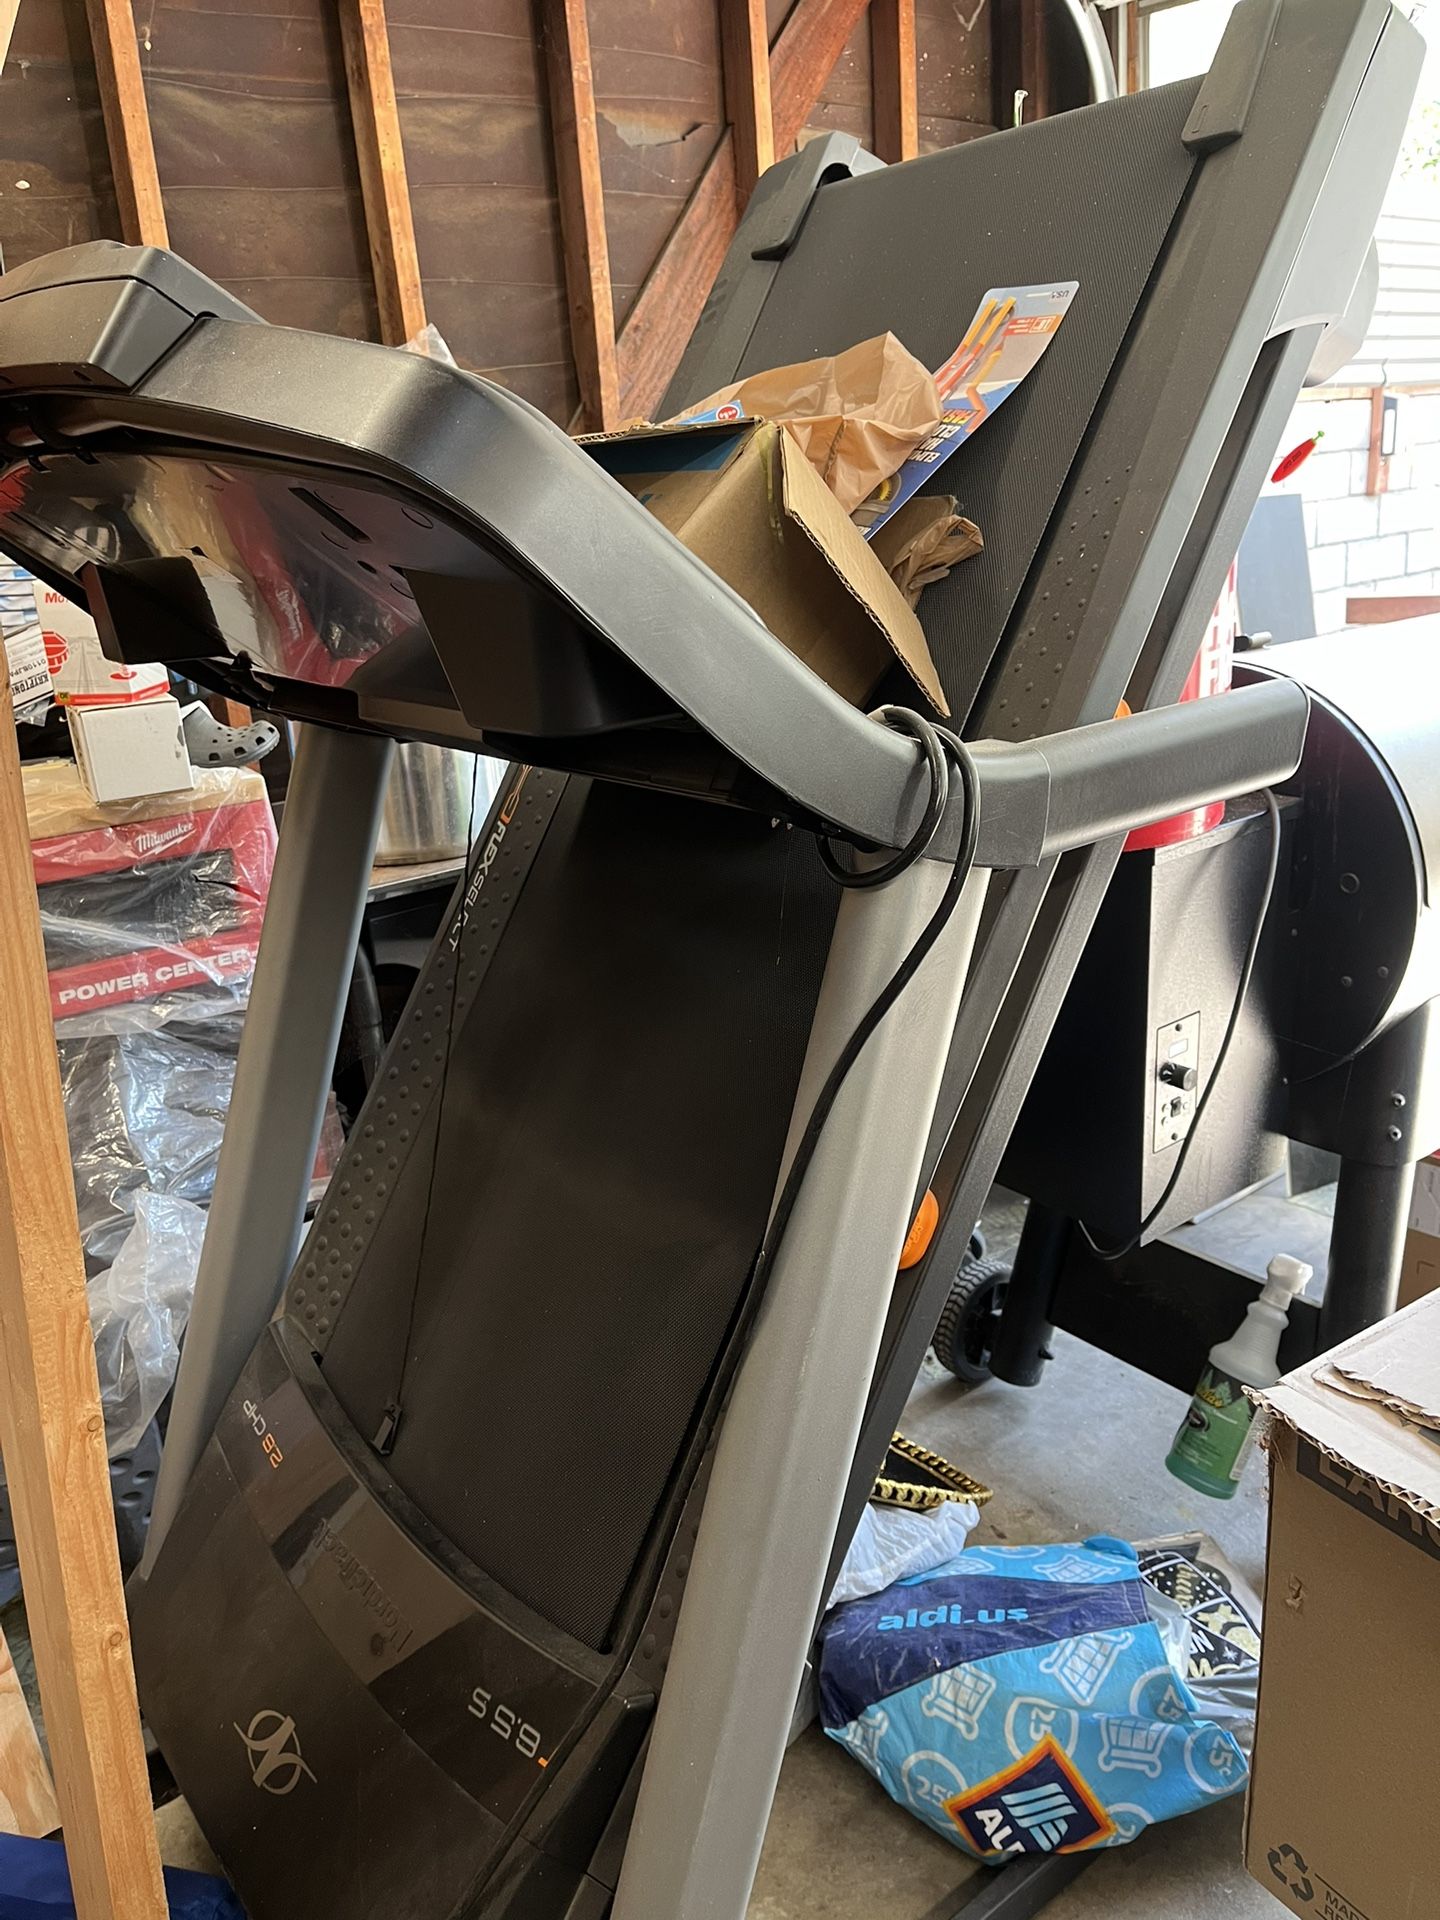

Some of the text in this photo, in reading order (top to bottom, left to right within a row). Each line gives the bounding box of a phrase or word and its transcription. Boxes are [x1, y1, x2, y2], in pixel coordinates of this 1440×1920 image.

[45, 592, 68, 604] Mo
[59, 949, 250, 1005] POWER CENTER
[242, 1399, 267, 1436] CHP
[877, 1603, 1029, 1631] aldi_us
[467, 1687, 492, 1719] S
[1029, 1706, 1056, 1742] 25
[974, 1808, 1026, 1853] AL
